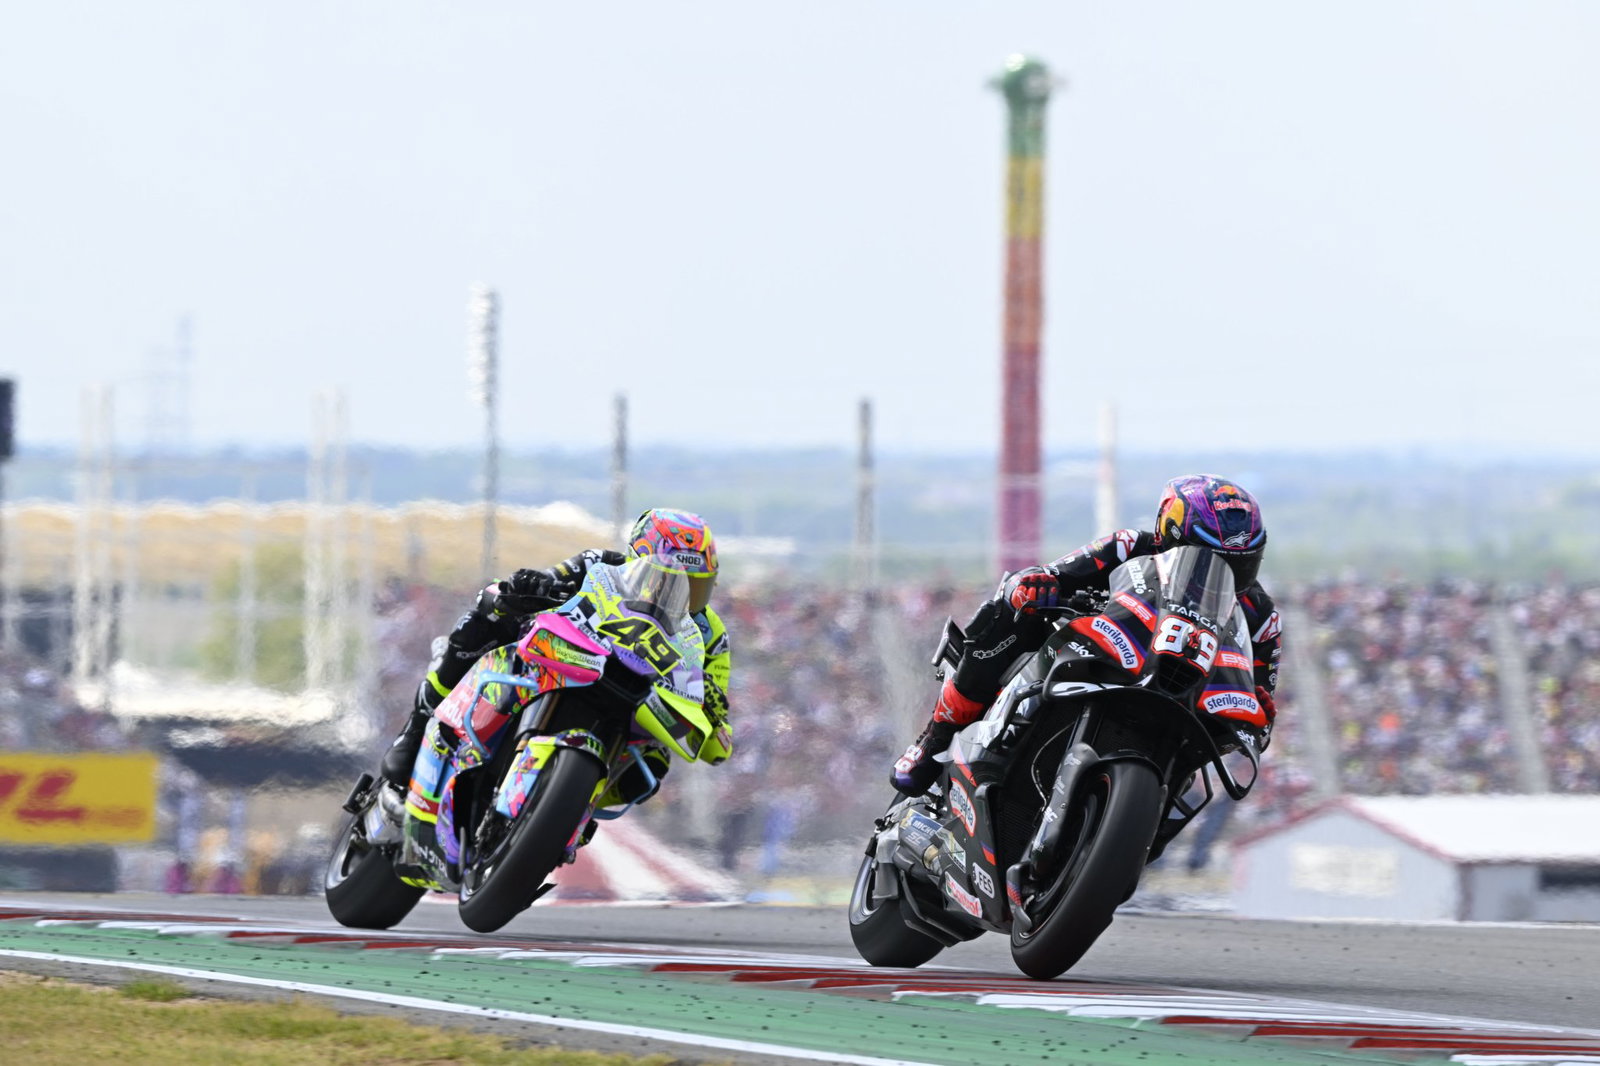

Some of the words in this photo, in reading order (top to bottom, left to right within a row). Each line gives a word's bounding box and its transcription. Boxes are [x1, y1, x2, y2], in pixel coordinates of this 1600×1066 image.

[1213, 499, 1234, 511] Red
[675, 553, 702, 567] SHOEI
[1168, 603, 1218, 635] TARGA
[595, 616, 684, 677] 49
[1068, 641, 1095, 658] sky
[1094, 620, 1136, 665] sterilgarda
[1151, 614, 1218, 677] 89
[1207, 694, 1256, 711] sterilgarda
